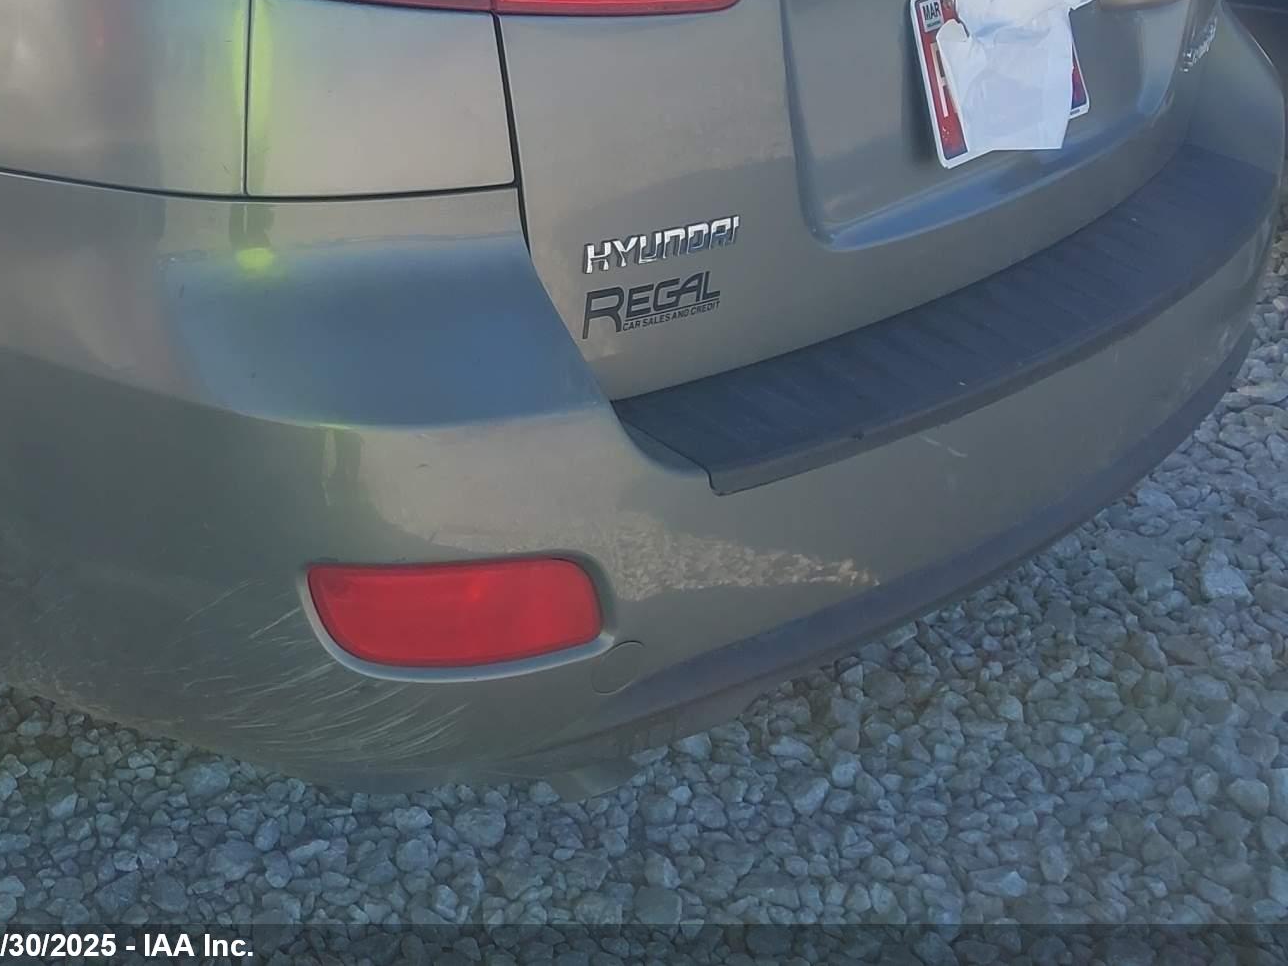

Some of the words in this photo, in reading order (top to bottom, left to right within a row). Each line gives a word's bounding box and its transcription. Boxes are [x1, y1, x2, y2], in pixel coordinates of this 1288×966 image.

[922, 1, 941, 20] MAR
[583, 215, 740, 274] HYUNDAI
[582, 271, 720, 339] REGAL
[623, 320, 640, 331] CAR
[642, 313, 670, 327] SALES
[671, 309, 689, 320] AND
[690, 300, 720, 315] CREDIT
